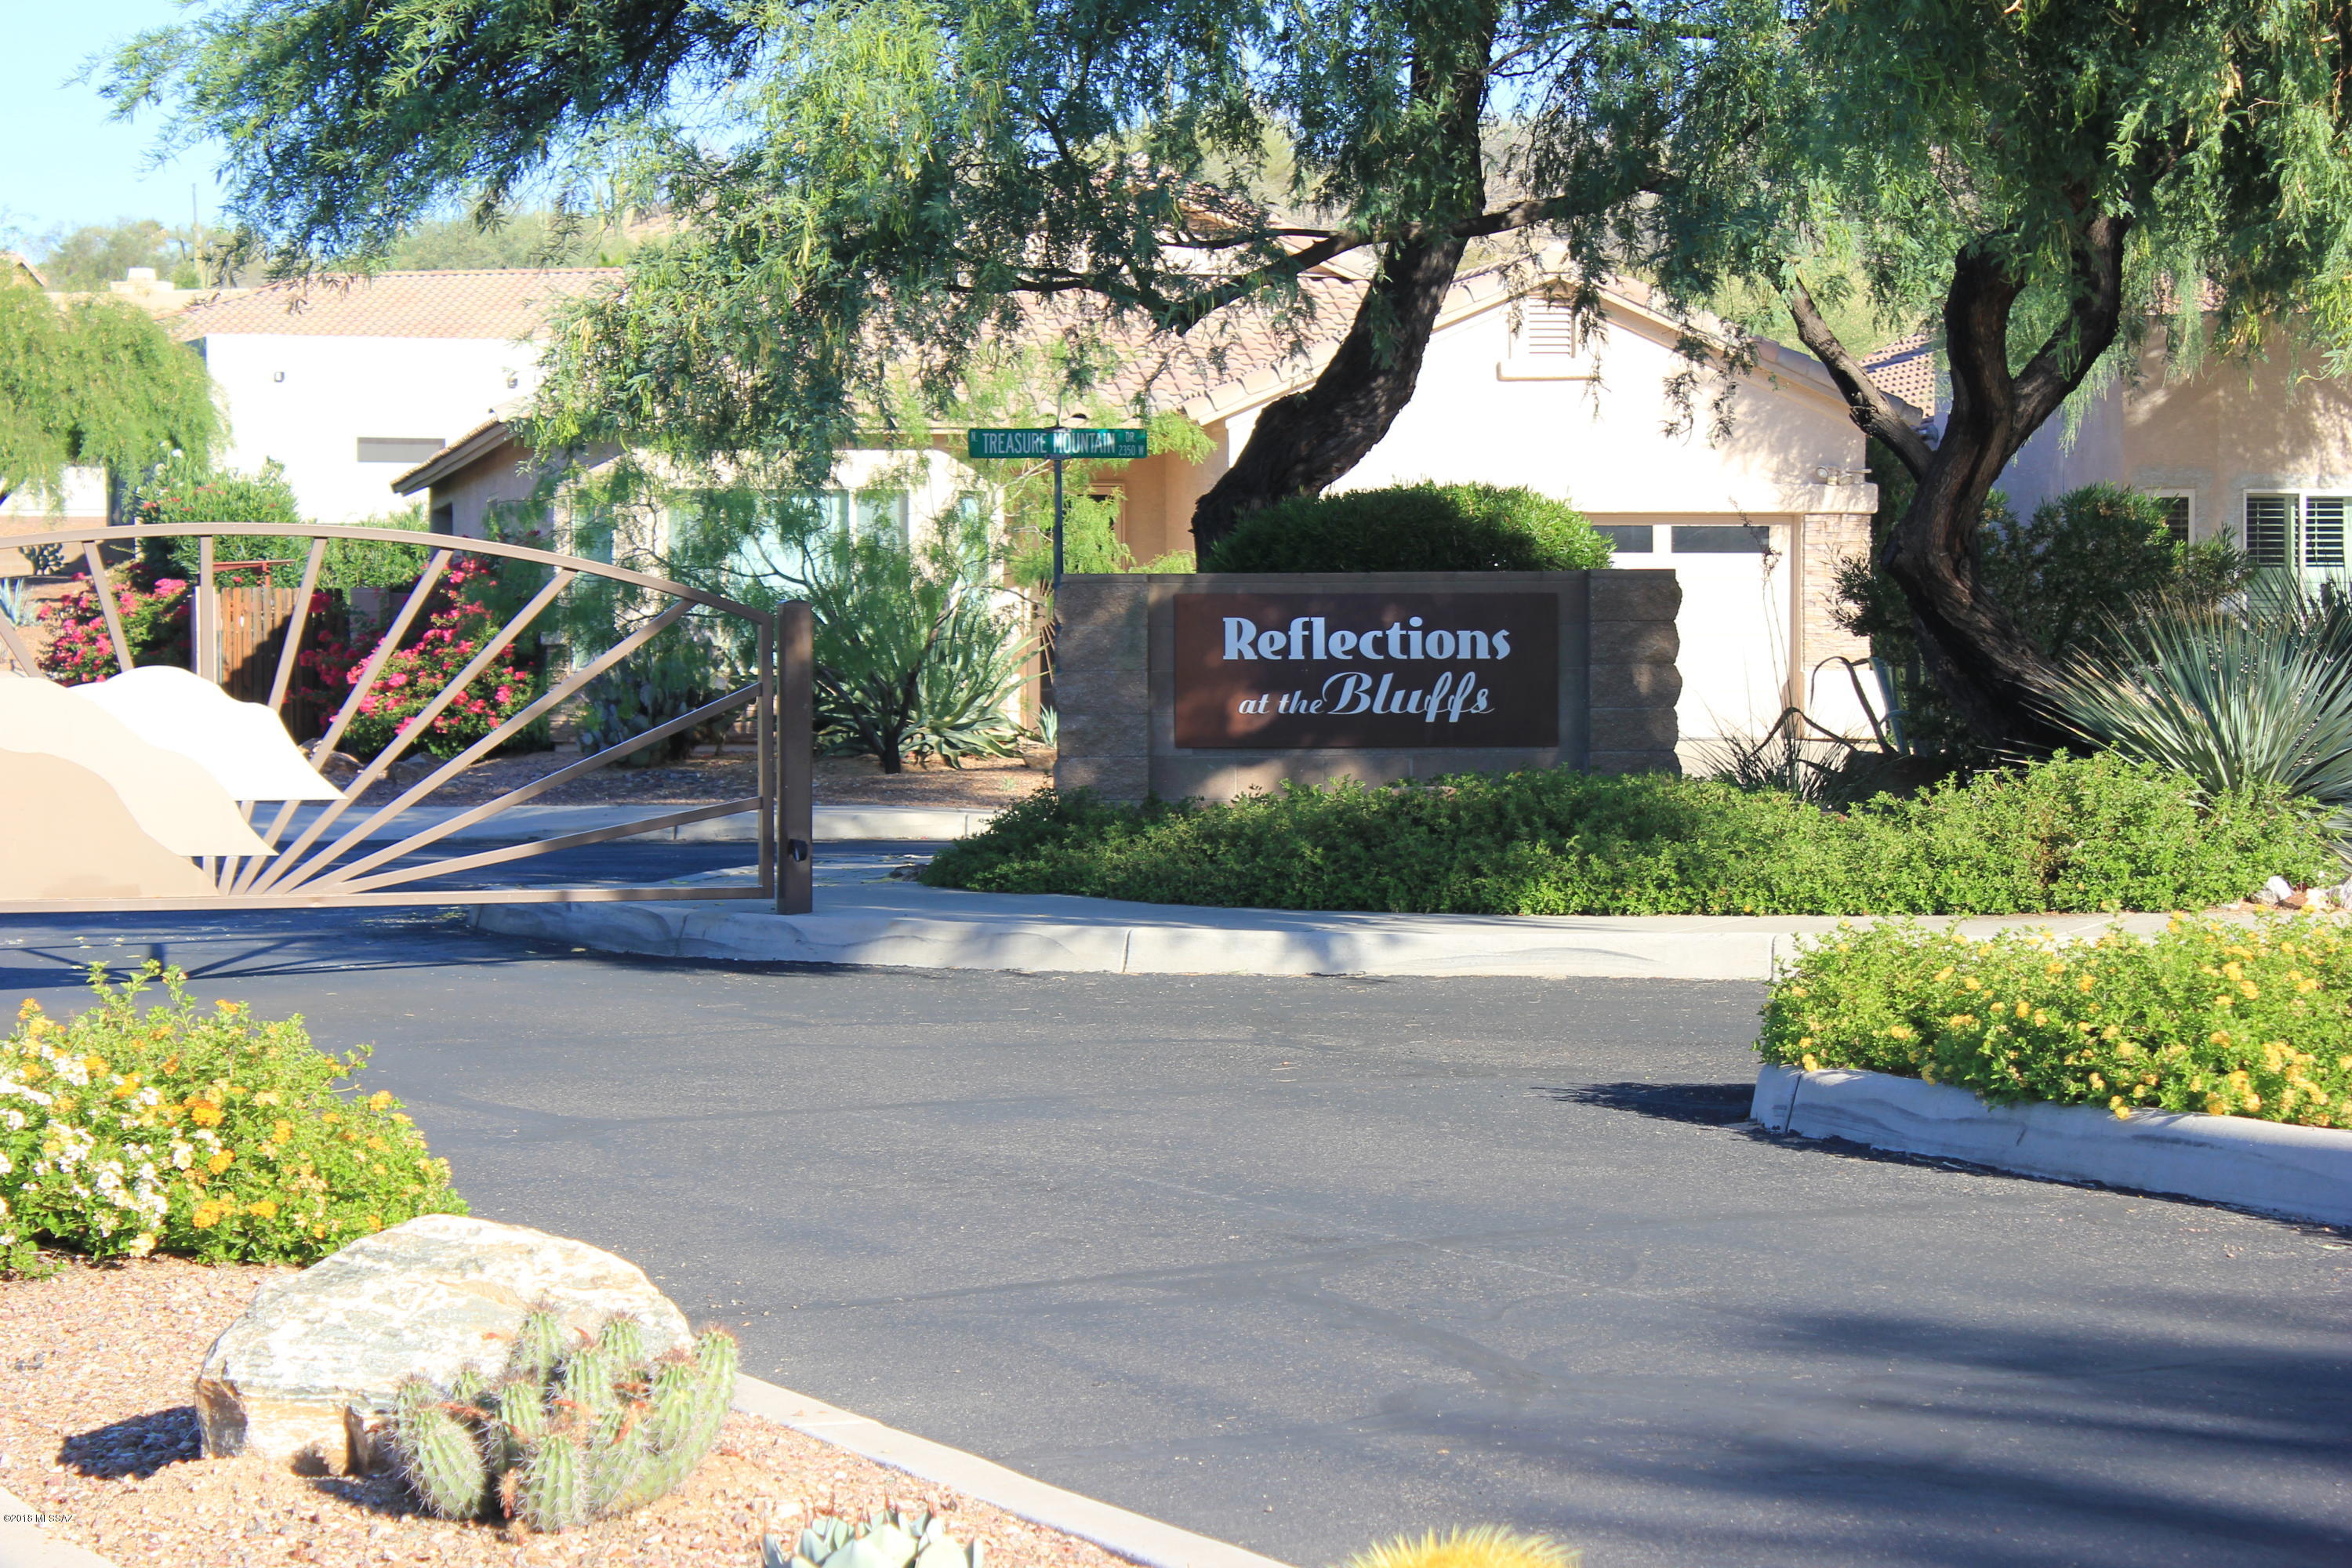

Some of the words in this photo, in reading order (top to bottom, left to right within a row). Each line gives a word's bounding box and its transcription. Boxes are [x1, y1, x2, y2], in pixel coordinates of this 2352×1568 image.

[982, 433, 1047, 454] TREASURE
[1053, 432, 1116, 454] MOUNTAIN
[1118, 445, 1135, 456] 2350
[1138, 445, 1144, 456] W
[1222, 616, 1511, 660] Reflections
[1238, 693, 1270, 714] at
[1278, 690, 1325, 714] the
[1323, 671, 1495, 723] Bluffs
